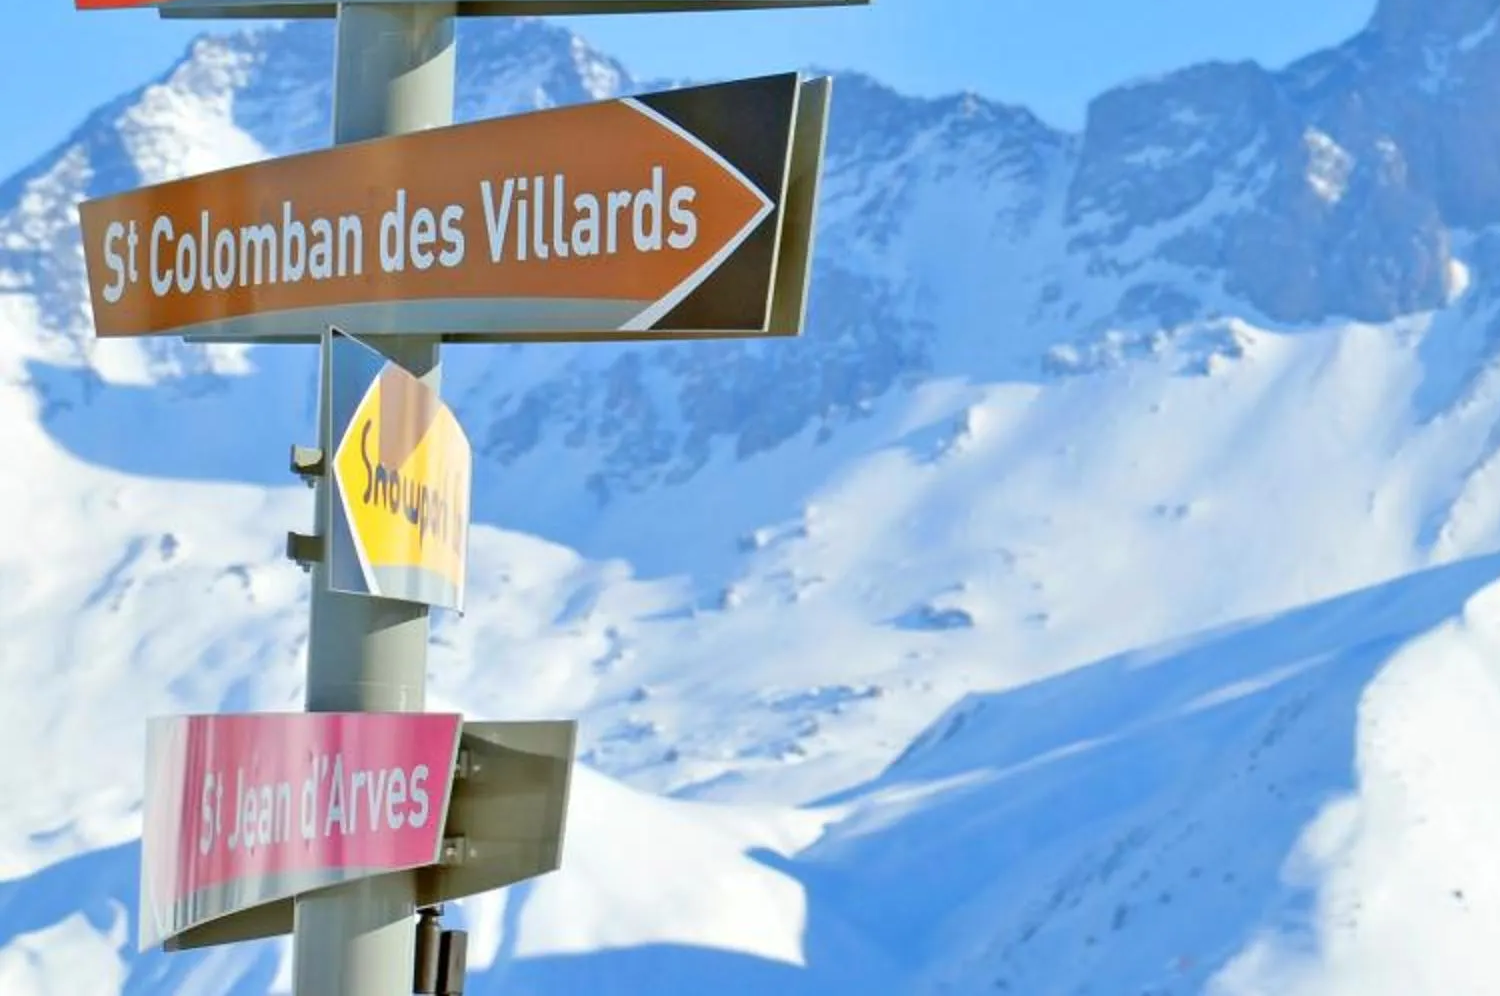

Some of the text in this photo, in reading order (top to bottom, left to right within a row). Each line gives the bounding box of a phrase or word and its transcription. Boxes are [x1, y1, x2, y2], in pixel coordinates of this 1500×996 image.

[102, 166, 697, 303] St Colomban des Villards
[200, 752, 429, 856] St Jean d'Arves
